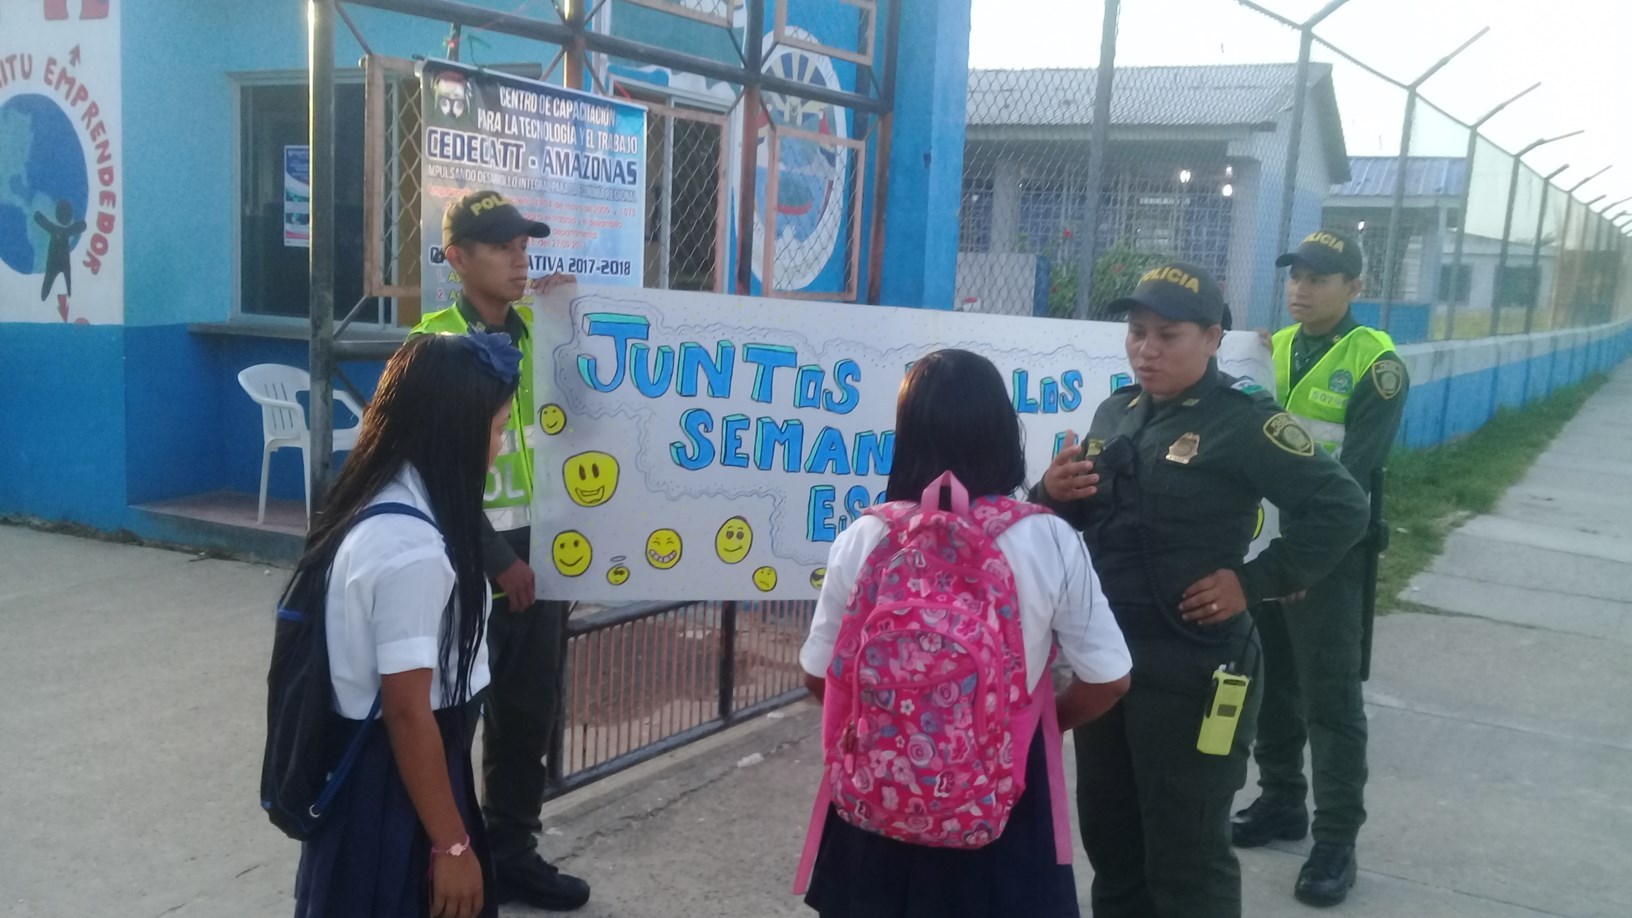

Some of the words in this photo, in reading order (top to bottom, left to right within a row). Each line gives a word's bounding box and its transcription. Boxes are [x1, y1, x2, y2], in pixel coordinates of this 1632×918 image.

[477, 108, 501, 132] PARA
[504, 113, 518, 136] LA
[519, 116, 576, 145] TECNOLOGÍA
[586, 128, 595, 149] EL
[597, 130, 638, 154] TRABAJO
[500, 87, 537, 112] CENTRO
[539, 94, 551, 116] DE
[553, 97, 616, 127] CAPACITACIÓN
[0, 53, 33, 88] ITU
[43, 56, 117, 275] EMPRENDEDOR
[426, 126, 525, 172] CEDECATT
[541, 146, 638, 186] AMAZONAS
[568, 257, 631, 275] 2017-2018
[577, 312, 861, 414] JUNTOS
[1012, 367, 1084, 414] LOS
[806, 484, 887, 542] ES
